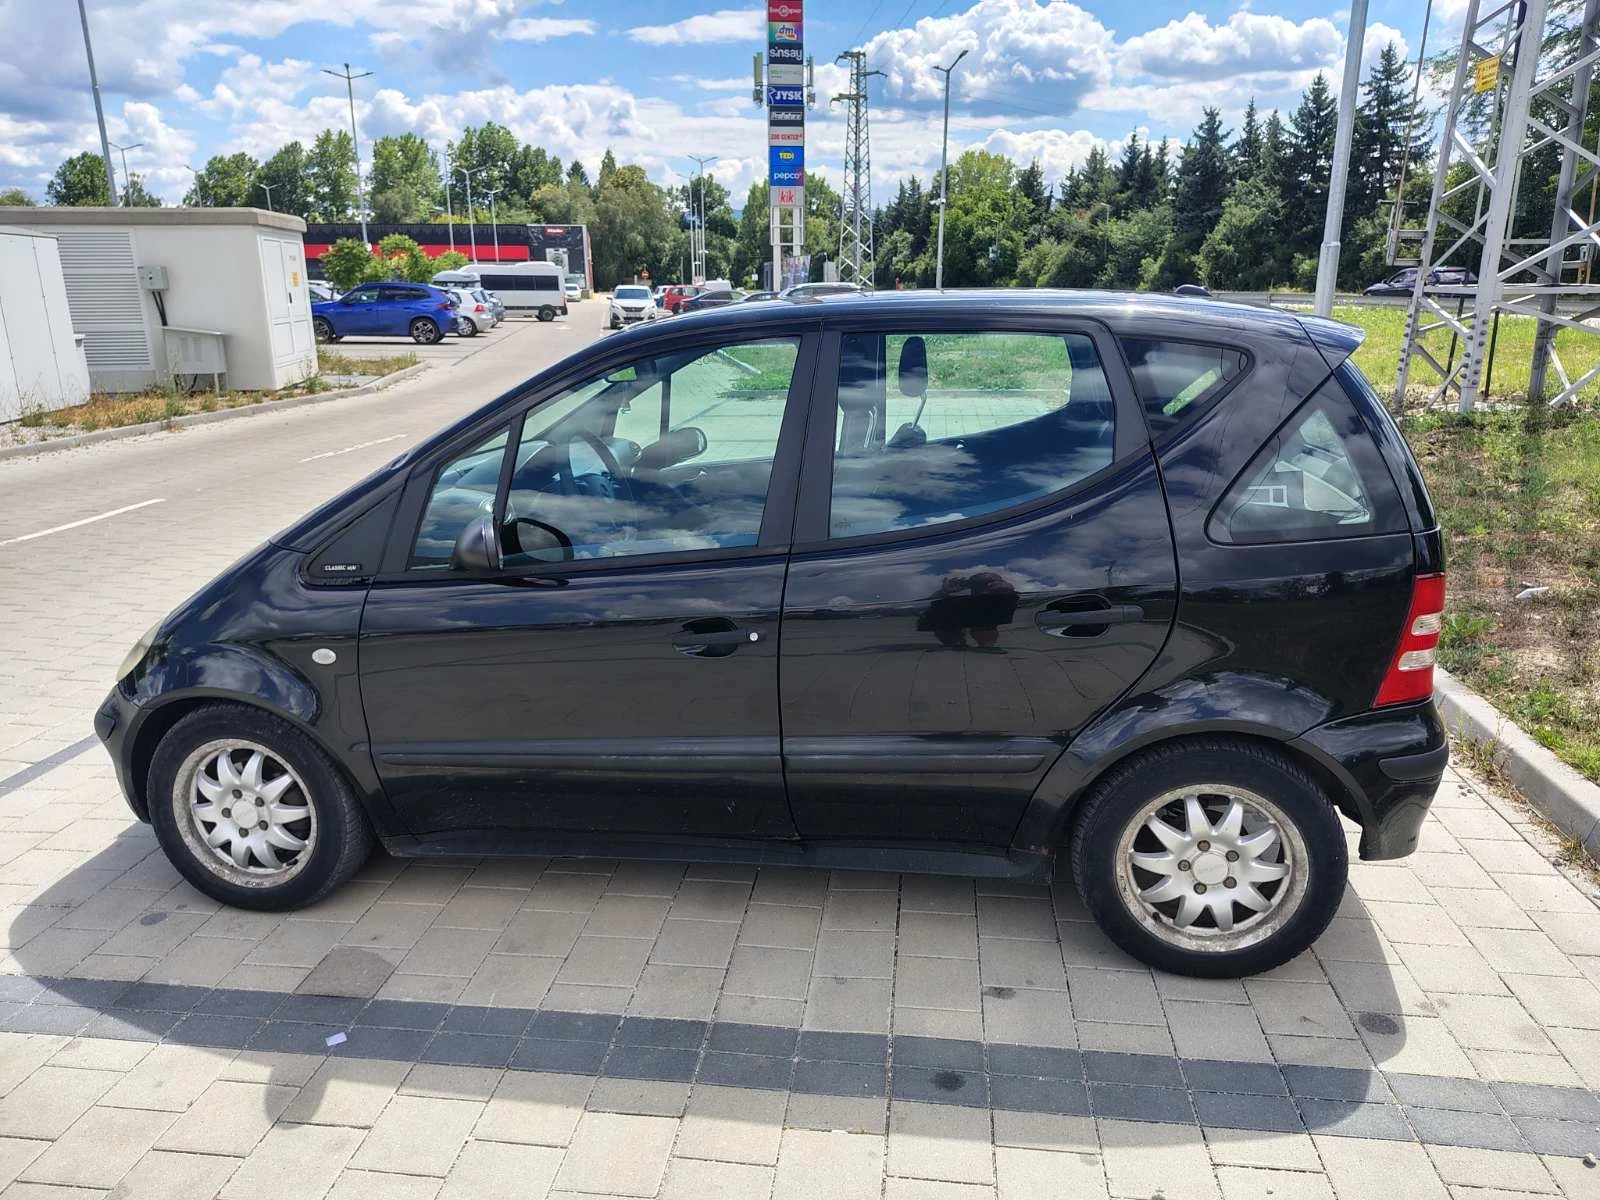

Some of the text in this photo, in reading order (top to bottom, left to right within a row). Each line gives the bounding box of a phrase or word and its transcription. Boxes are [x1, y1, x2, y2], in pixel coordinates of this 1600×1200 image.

[779, 25, 794, 35] dm
[769, 47, 802, 60] sinsay
[775, 91, 802, 100] JYSK
